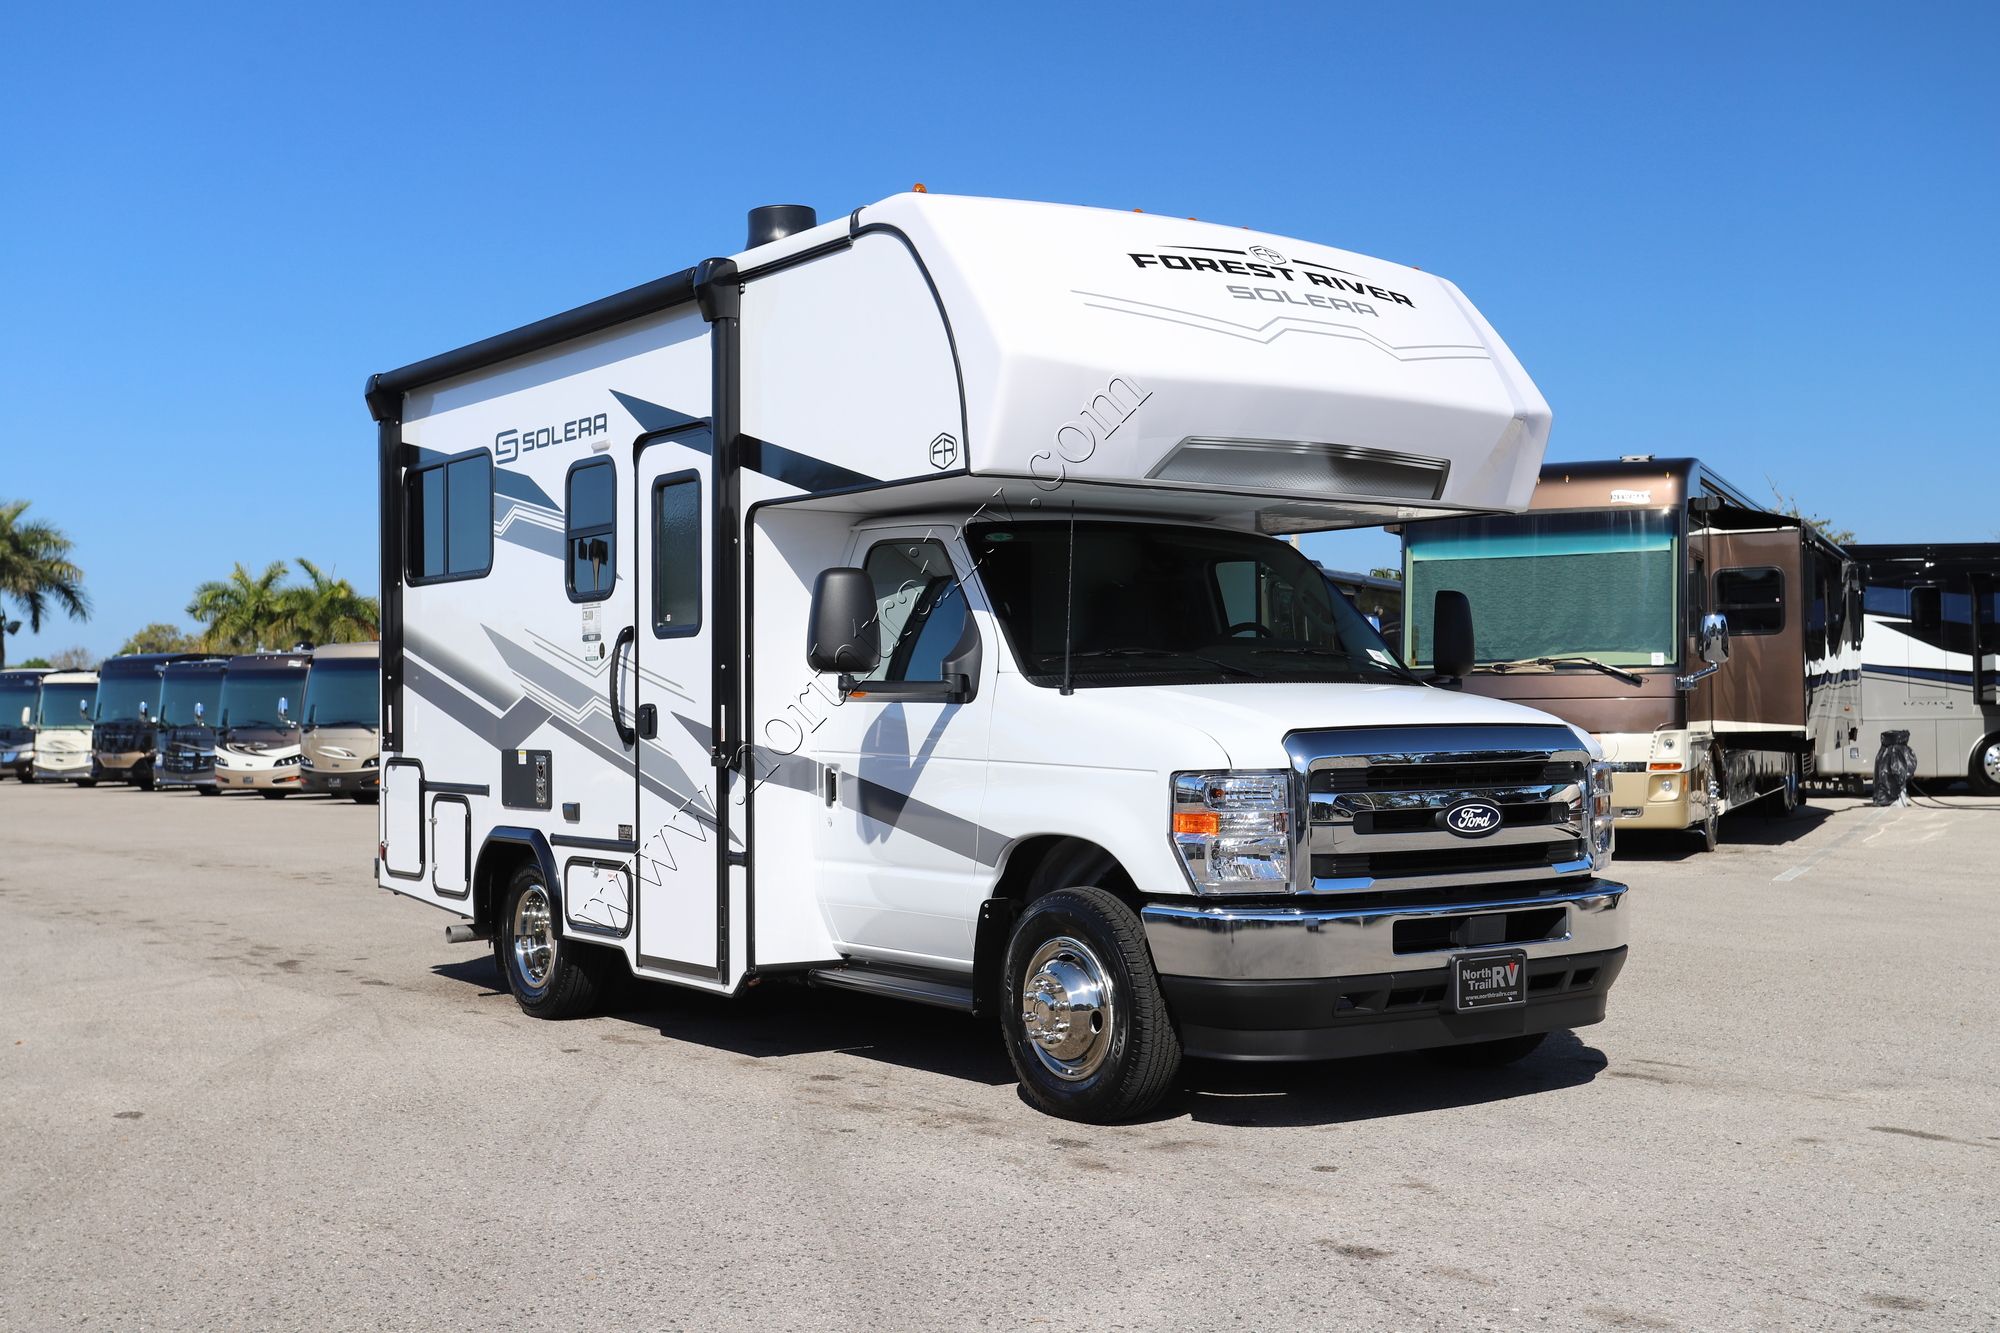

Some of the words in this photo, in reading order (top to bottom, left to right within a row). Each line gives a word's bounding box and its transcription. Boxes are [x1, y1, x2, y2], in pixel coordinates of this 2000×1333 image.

[1127, 253, 1295, 281] FOREST
[1302, 270, 1418, 309] RIVER
[1226, 286, 1380, 317] SOLERA
[522, 412, 608, 453] SOLERA
[1457, 807, 1491, 828] Ford
[1462, 967, 1492, 981] North
[1492, 963, 1520, 988] RV
[1468, 978, 1492, 991] Trail
